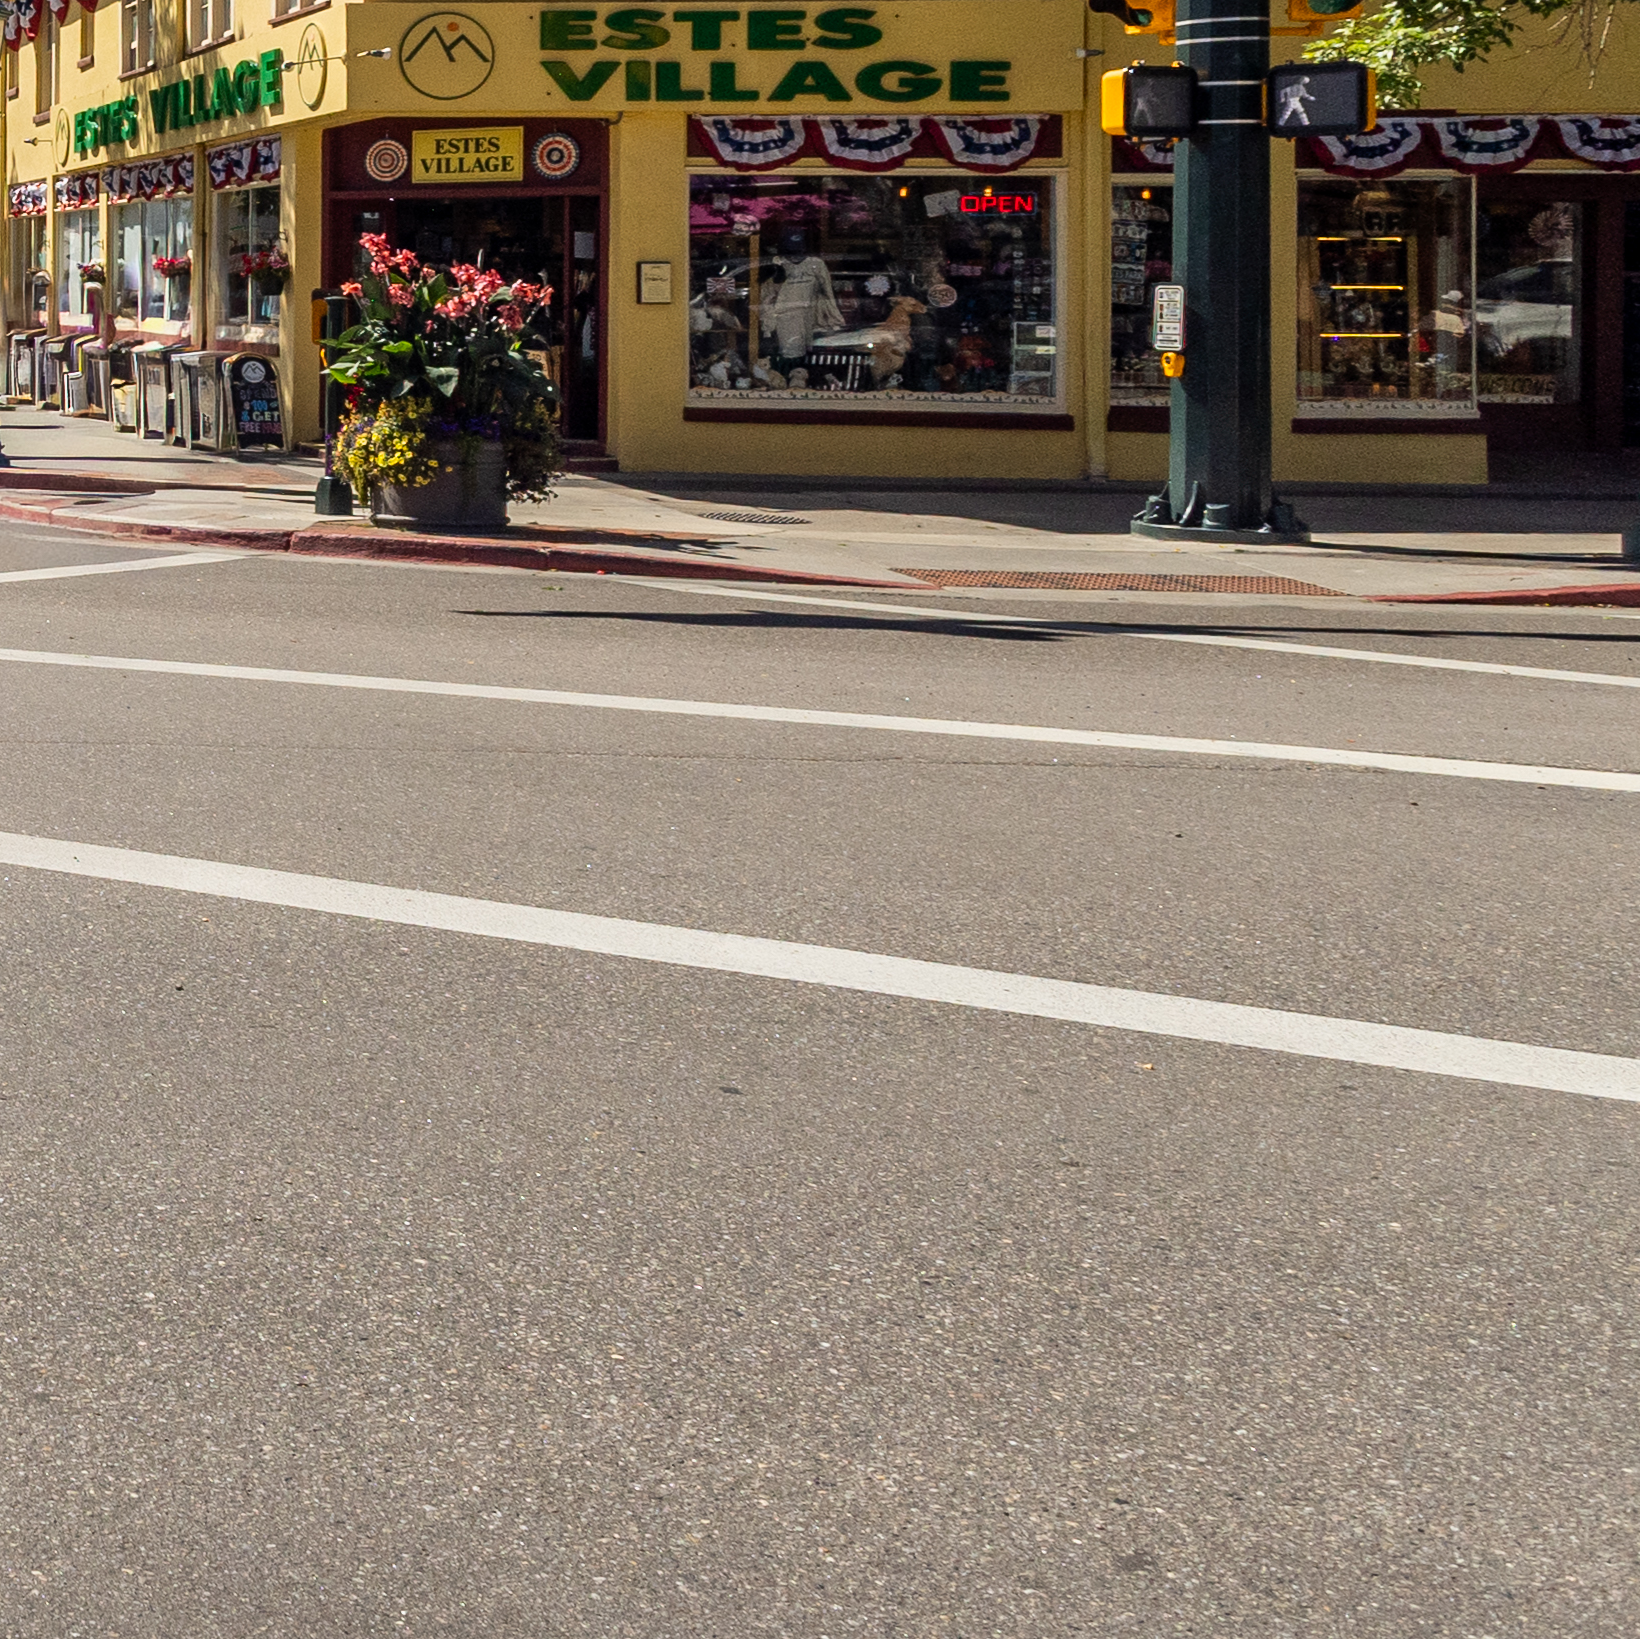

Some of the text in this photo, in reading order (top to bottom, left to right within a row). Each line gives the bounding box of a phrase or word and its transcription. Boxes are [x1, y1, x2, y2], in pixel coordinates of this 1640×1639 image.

[540, 9, 883, 51] ESTES
[540, 60, 1011, 102] VILLAGE
[74, 48, 282, 153] ESTES VILLAGE
[434, 136, 500, 155] ESTES
[420, 155, 515, 175] VILLAGE
[960, 195, 1033, 212] OPEN
[253, 411, 279, 422] GET
